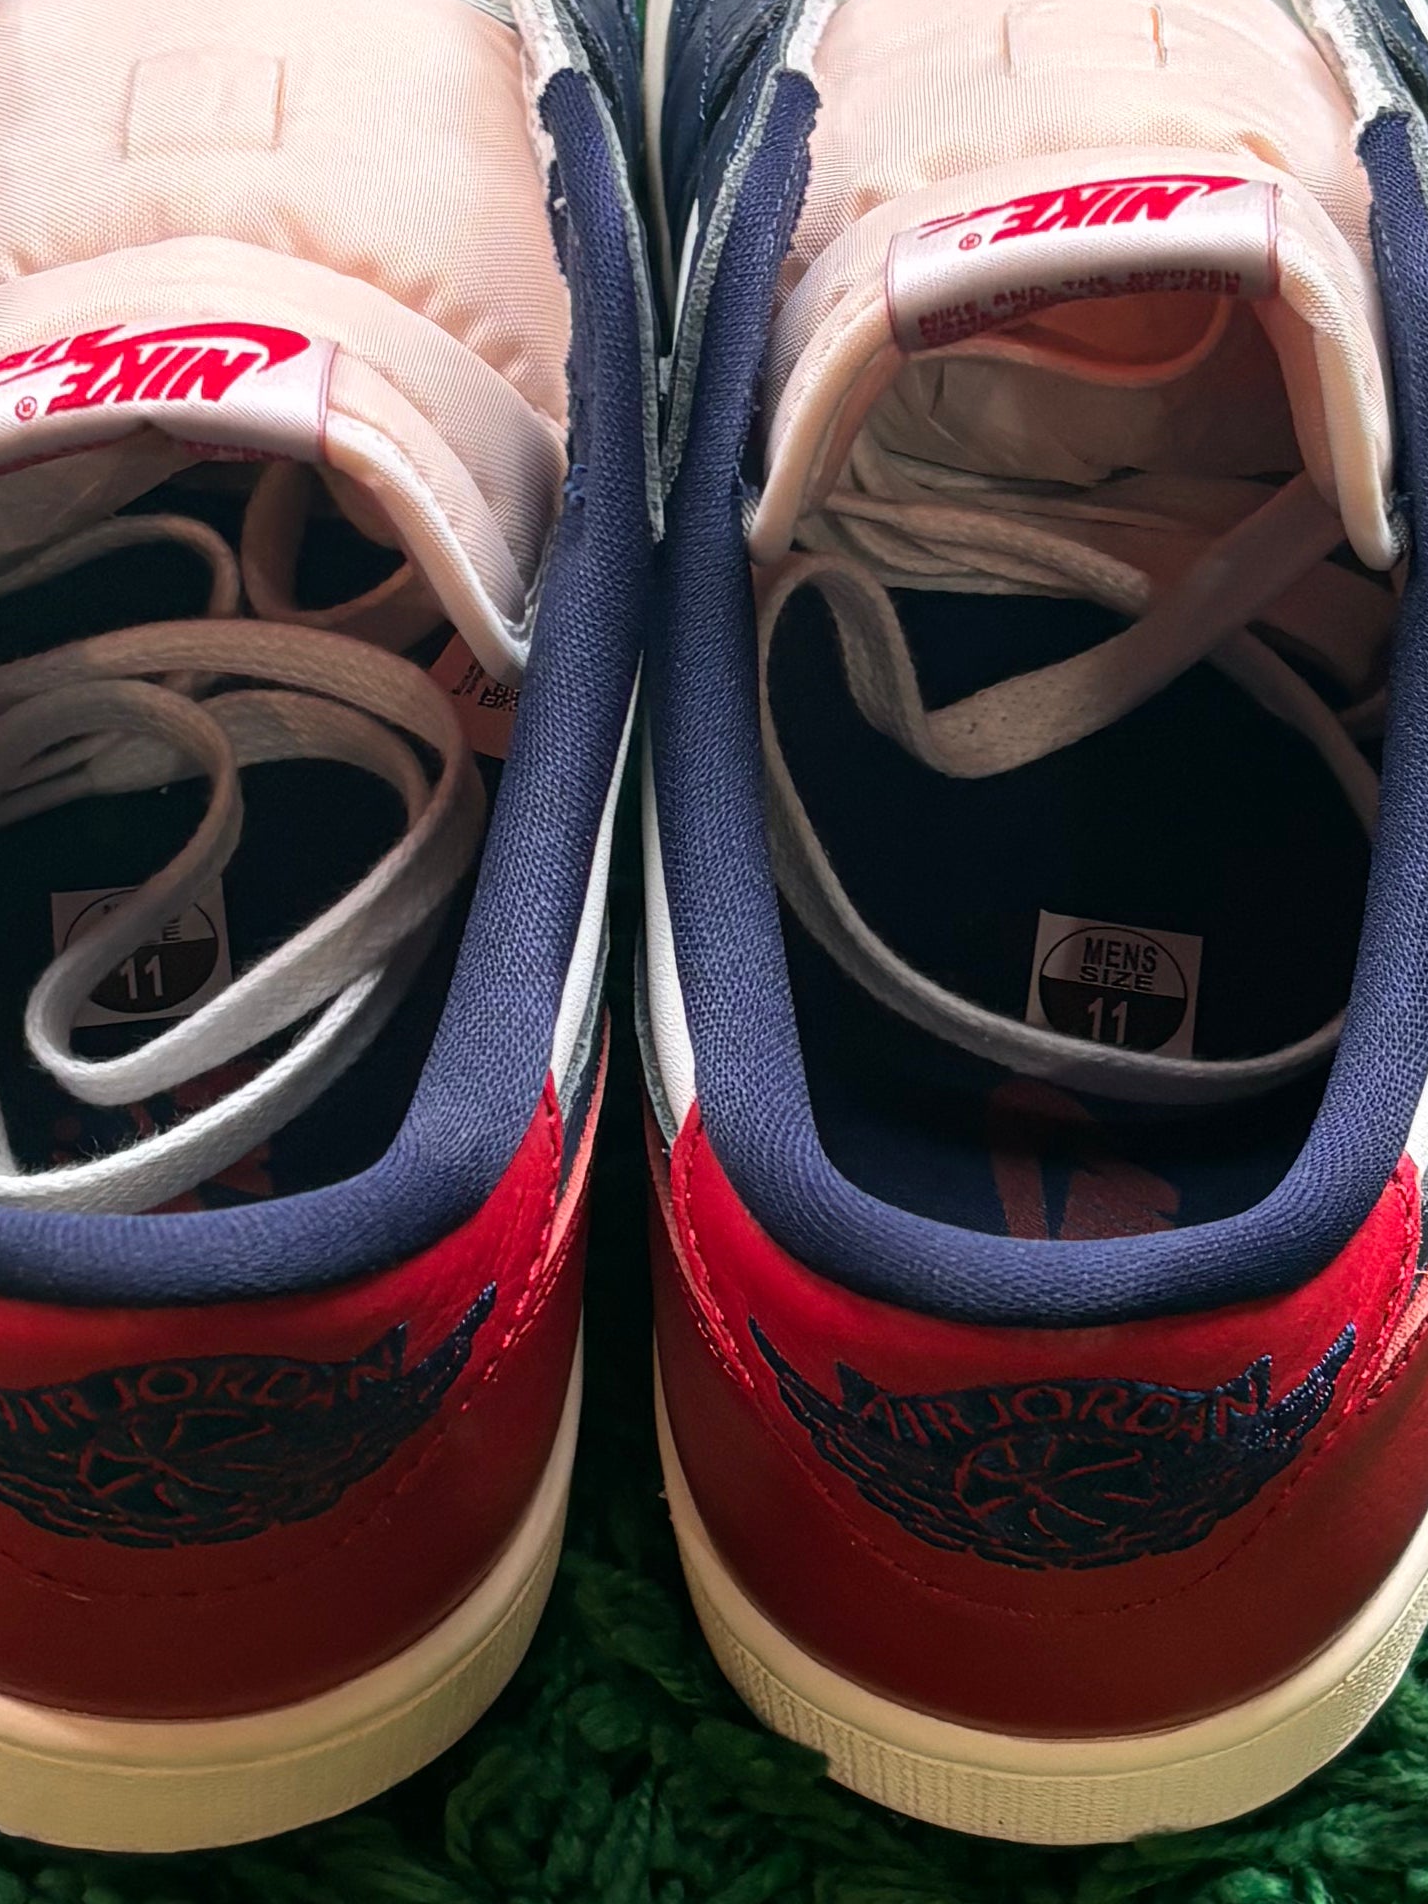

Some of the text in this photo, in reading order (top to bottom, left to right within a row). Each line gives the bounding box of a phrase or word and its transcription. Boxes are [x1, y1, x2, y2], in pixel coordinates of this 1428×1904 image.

[989, 184, 1198, 245] NIKE
[45, 345, 263, 416] NIKE
[121, 954, 165, 1000] 11
[1079, 965, 1154, 992] SIZE
[1083, 936, 1158, 973] MENS
[1087, 997, 1128, 1044] 11
[113, 1344, 394, 1414] JORDAN
[862, 1379, 1260, 1447] AIR JORDAN
